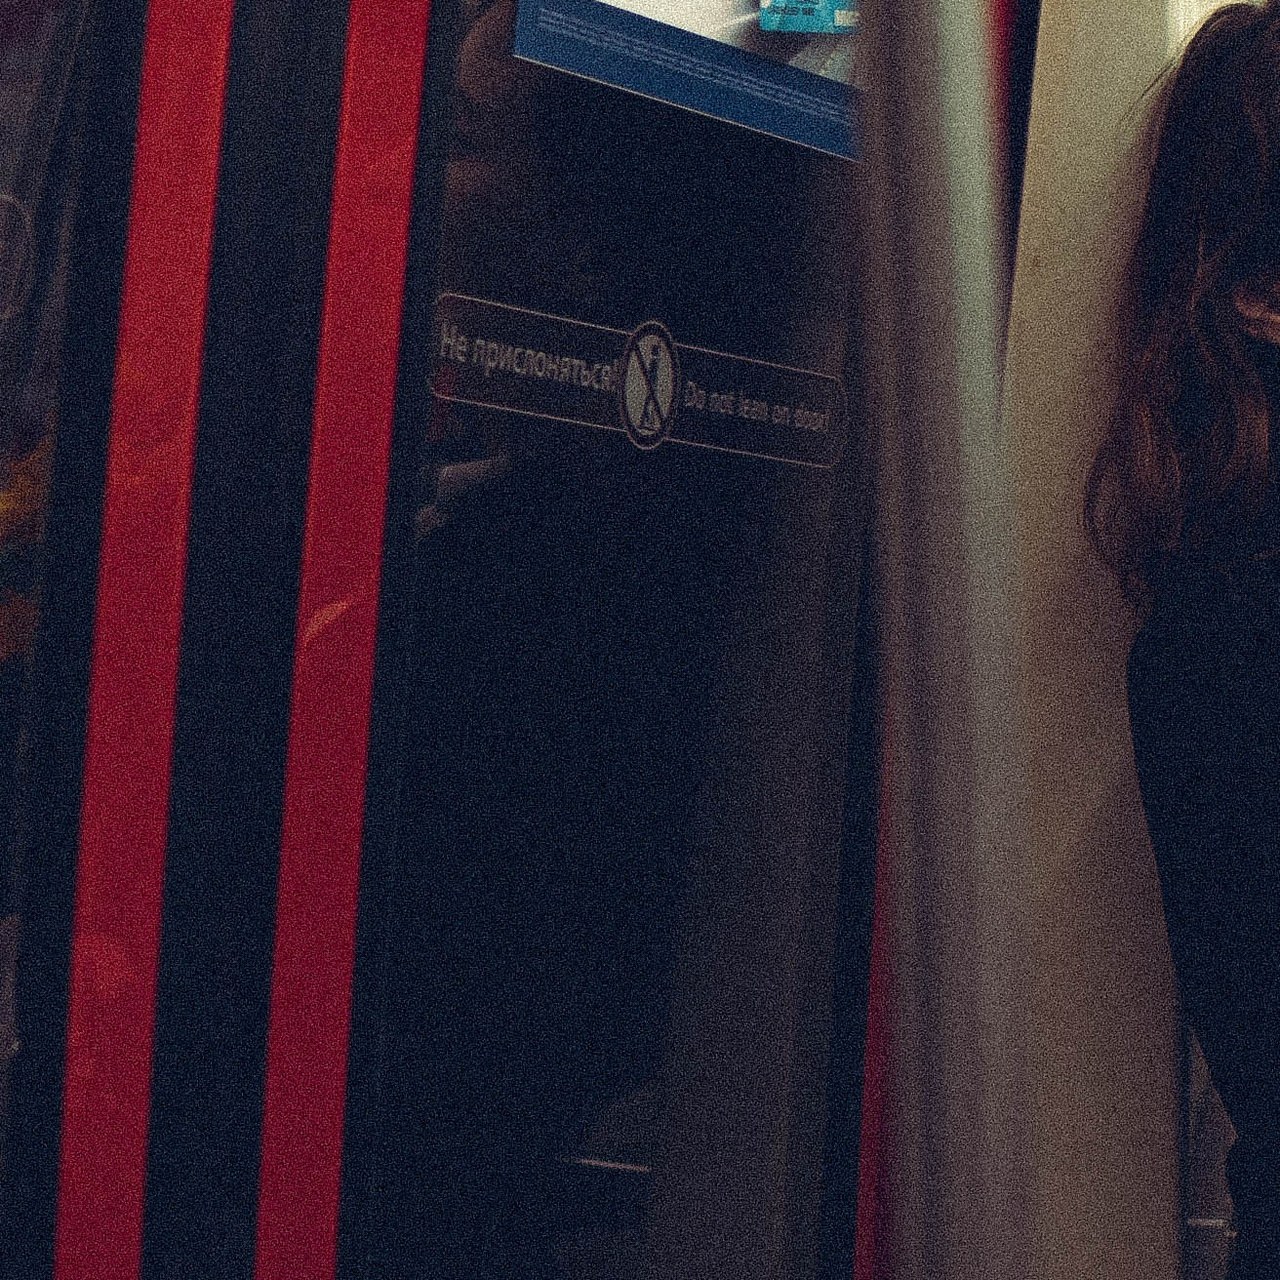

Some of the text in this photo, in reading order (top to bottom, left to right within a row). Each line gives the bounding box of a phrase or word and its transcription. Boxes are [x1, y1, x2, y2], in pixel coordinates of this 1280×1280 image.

[440, 318, 620, 392] Не прислоняться!
[685, 380, 706, 410] Do
[709, 390, 736, 415] not
